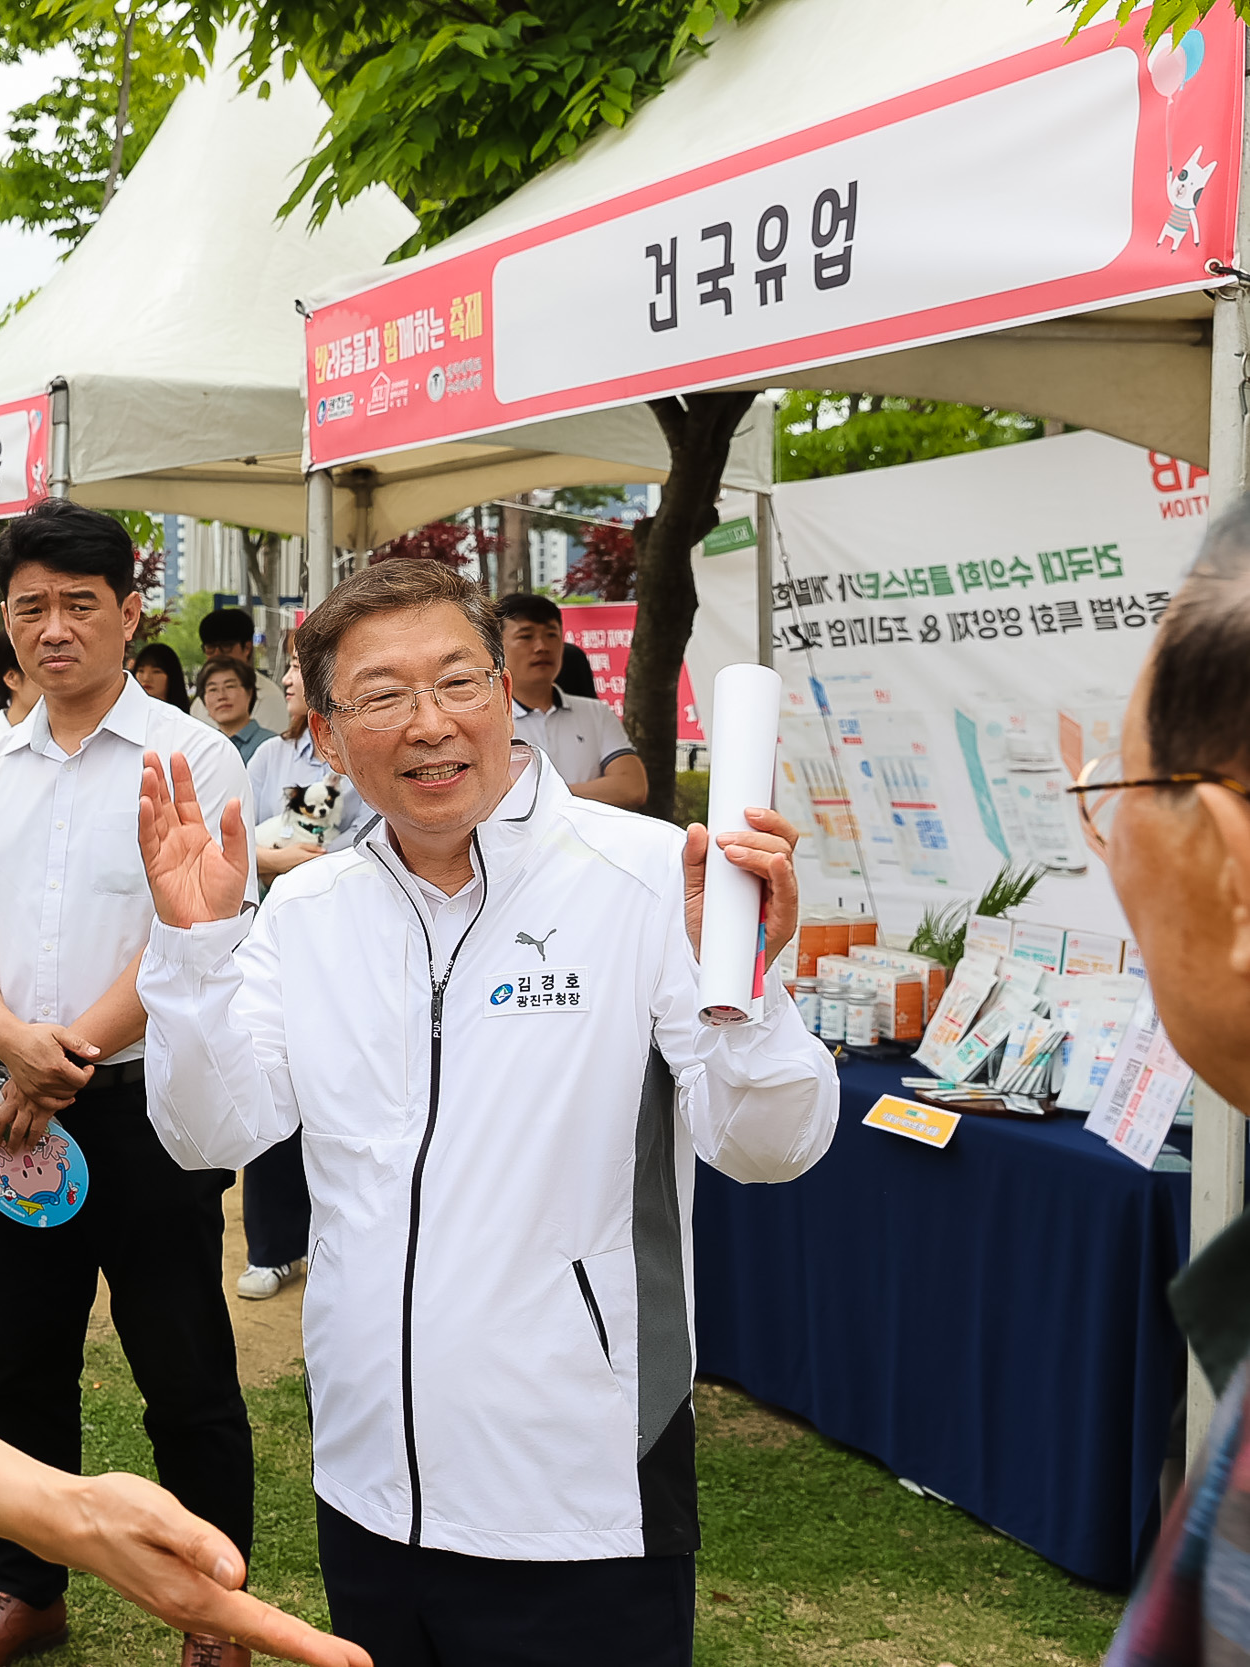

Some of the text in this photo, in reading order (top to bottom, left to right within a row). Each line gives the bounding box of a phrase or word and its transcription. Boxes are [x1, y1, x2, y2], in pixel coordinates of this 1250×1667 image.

[645, 180, 858, 333] 건국유업
[315, 327, 381, 384] 반려동물과
[383, 307, 445, 365] 함께하는
[450, 291, 483, 342] 축제
[516, 992, 581, 1008] 광진구청장
